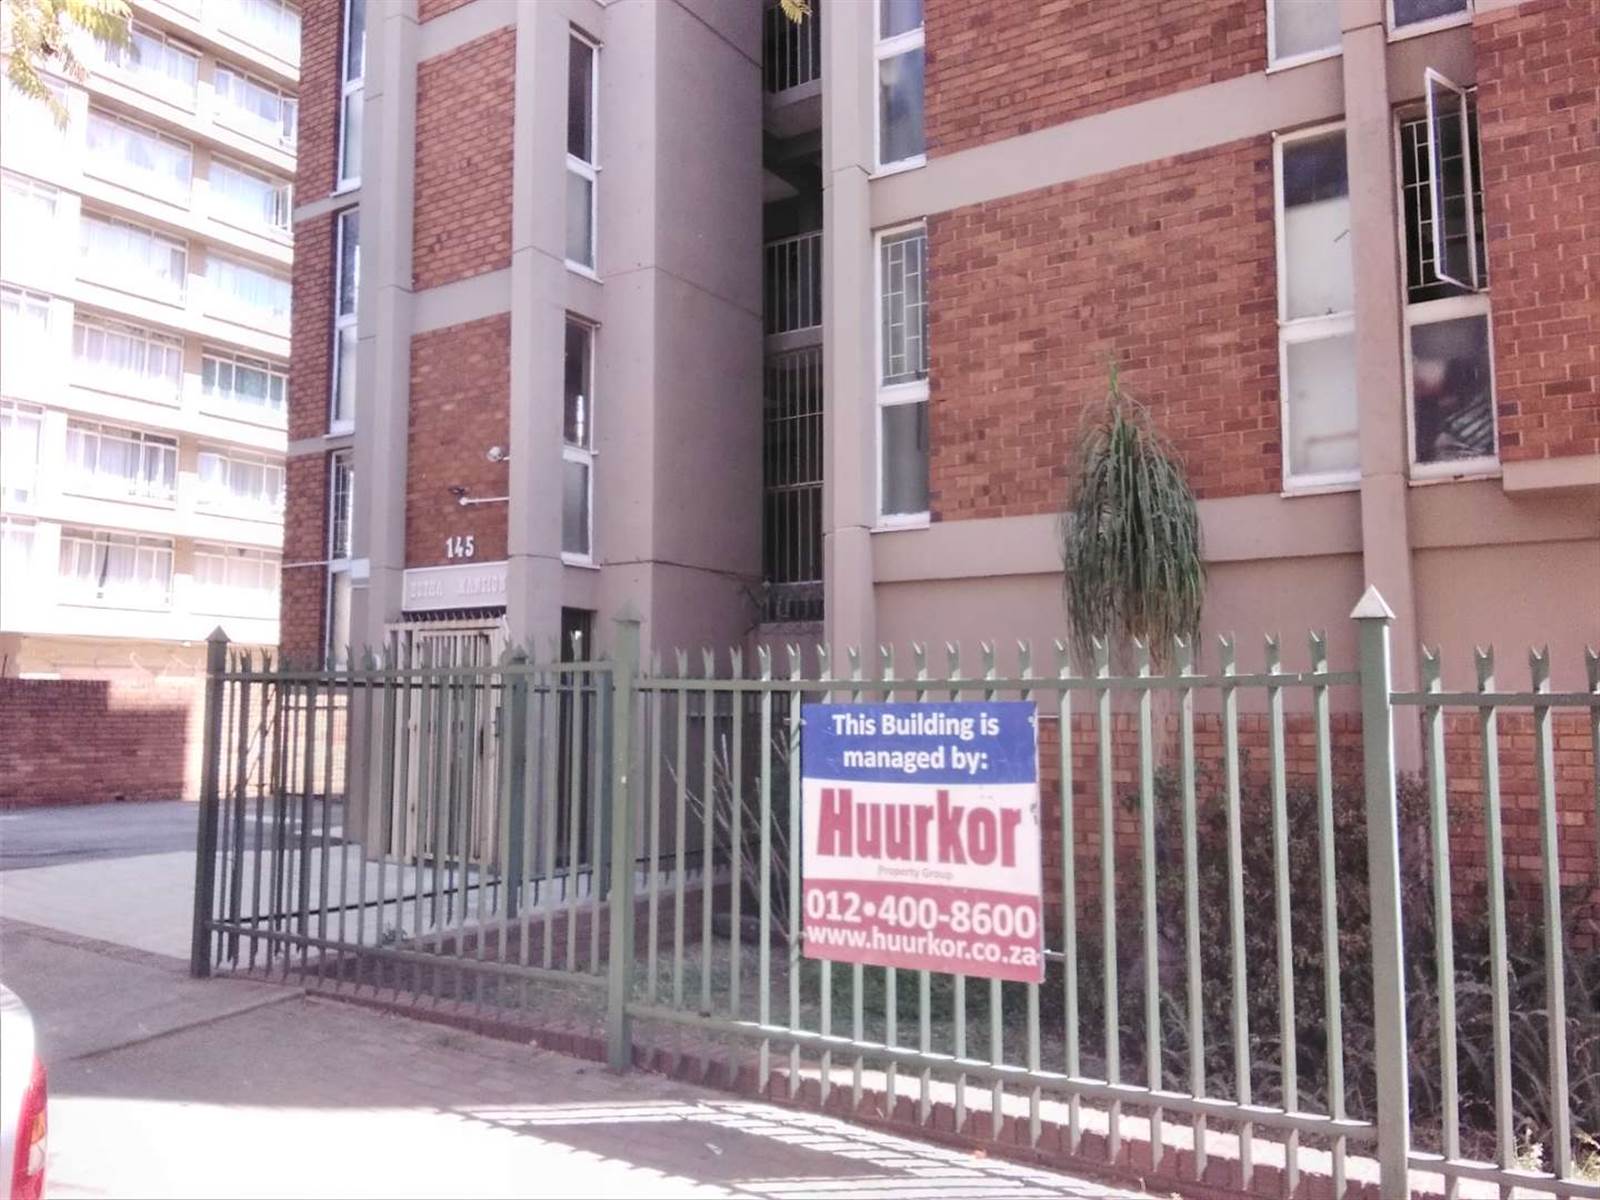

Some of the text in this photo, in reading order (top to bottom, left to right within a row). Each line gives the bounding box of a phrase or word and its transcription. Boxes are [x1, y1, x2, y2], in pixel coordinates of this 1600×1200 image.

[446, 535, 474, 558] 145
[832, 712, 1000, 741] This Building is
[843, 746, 988, 775] managed by:
[817, 788, 1022, 868] Huurkor
[877, 865, 954, 880] Property Group
[806, 925, 1037, 967] www.huurkor.co.za
